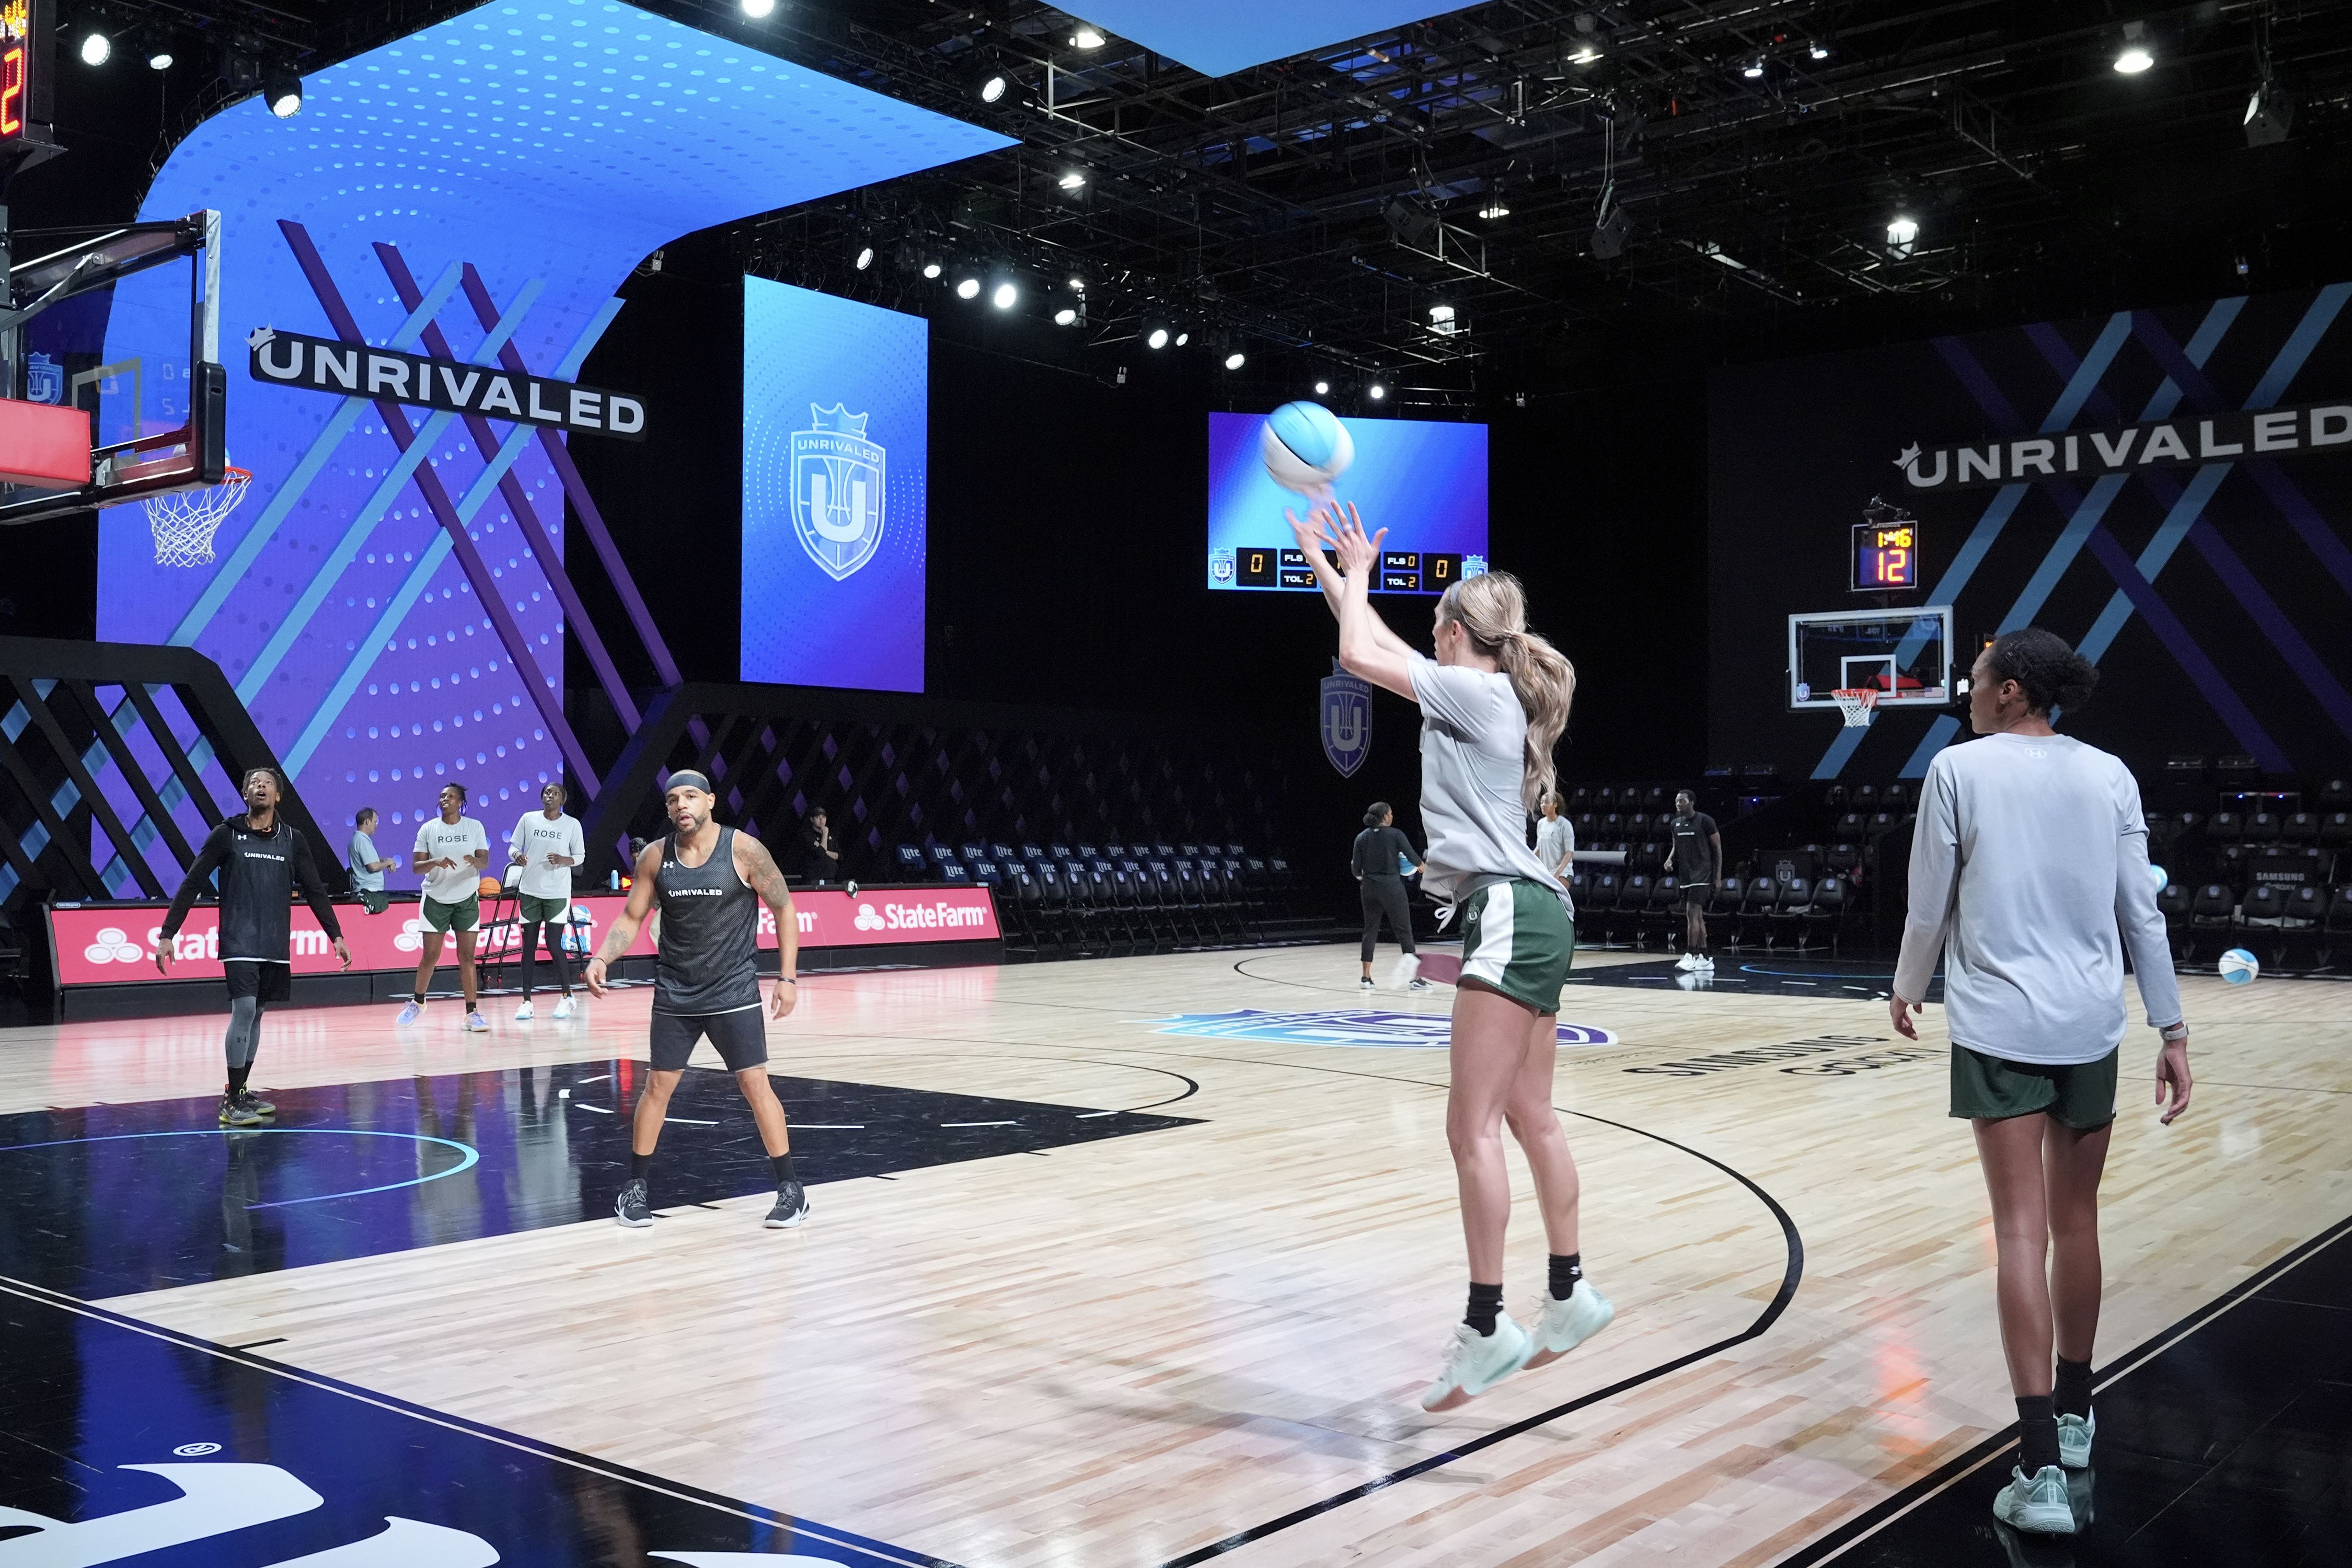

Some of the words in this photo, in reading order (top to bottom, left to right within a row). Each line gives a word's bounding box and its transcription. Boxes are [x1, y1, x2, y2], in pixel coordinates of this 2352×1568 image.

[256, 340, 644, 433] UNRIVALED
[798, 439, 880, 464] UNRIVALED
[1906, 405, 2352, 488] UNRIVALED
[1250, 554, 1263, 573] 0
[1408, 556, 1415, 567] 0
[1878, 549, 1906, 581] 12
[1436, 560, 1448, 578] 0
[1306, 573, 1313, 585] 2
[1408, 577, 1416, 587] 2
[1324, 680, 1369, 693] UNRIVALED
[438, 835, 468, 843] ROSE
[534, 829, 562, 839] ROSE
[244, 852, 285, 861] UNRIVALED
[901, 848, 920, 860] Lite
[935, 848, 953, 860] Lite
[965, 847, 983, 859] Lite
[996, 846, 1013, 857] Lite
[1025, 846, 1042, 857] Lite
[1054, 847, 1070, 858] Lite
[1080, 846, 1097, 857] Lite
[1109, 846, 1125, 857] Lite
[1134, 846, 1149, 857] Lite
[978, 863, 997, 875] Lite
[1009, 863, 1027, 875] Lite
[1040, 863, 1056, 874] Lite
[1068, 862, 1085, 874] Lite
[1096, 862, 1113, 872] Lite
[1124, 861, 1140, 872] Lite
[1150, 861, 1167, 872] Lite
[1176, 860, 1192, 871] Lite
[945, 865, 964, 878] Lite
[2256, 872, 2304, 881] SAMSUNG
[668, 889, 722, 897] UNRIVALED
[1178, 1011, 1375, 1033] UNRIVALED
[1622, 1035, 1890, 1076] SAMSUNG
